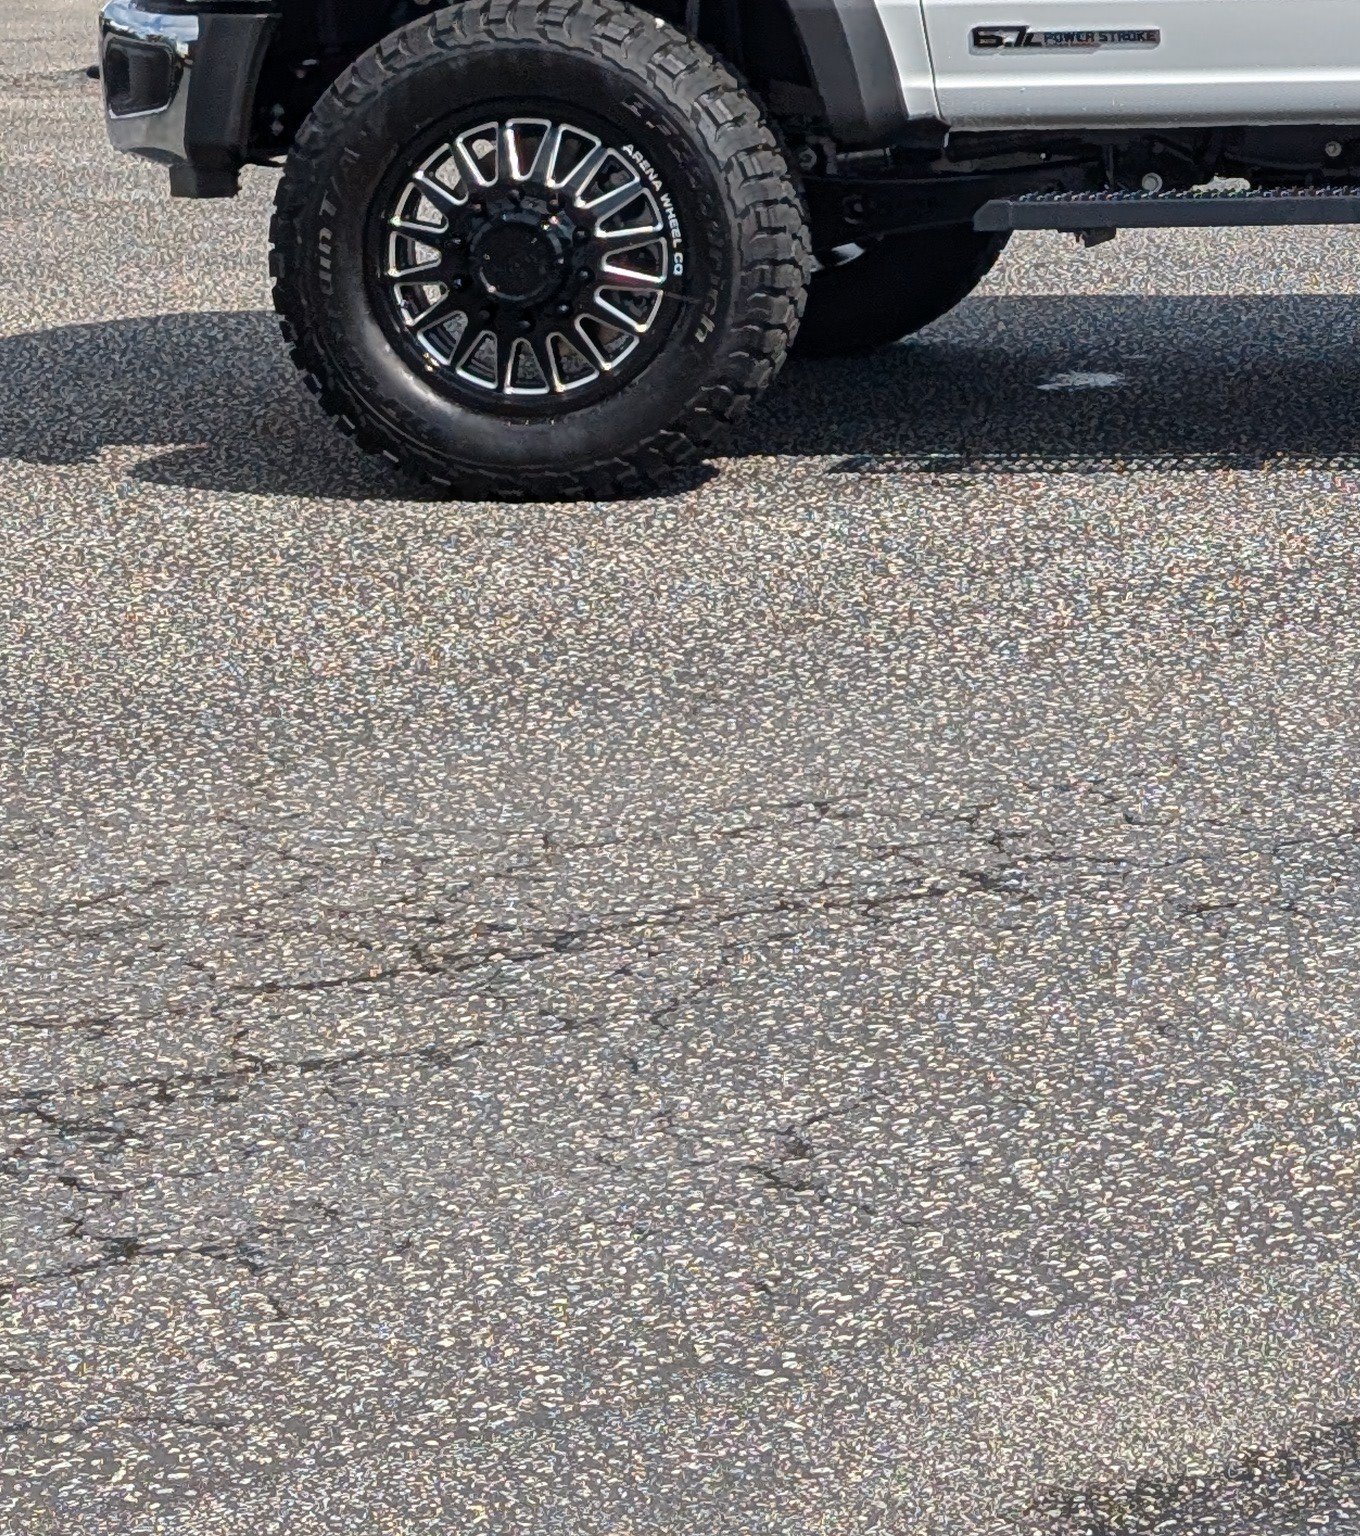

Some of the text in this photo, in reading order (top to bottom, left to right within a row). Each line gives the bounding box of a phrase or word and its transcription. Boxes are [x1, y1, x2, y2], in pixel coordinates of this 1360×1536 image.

[1043, 32, 1095, 43] POWER
[1099, 30, 1156, 42] STROKE
[622, 144, 684, 276] ARENA WHEEL CO
